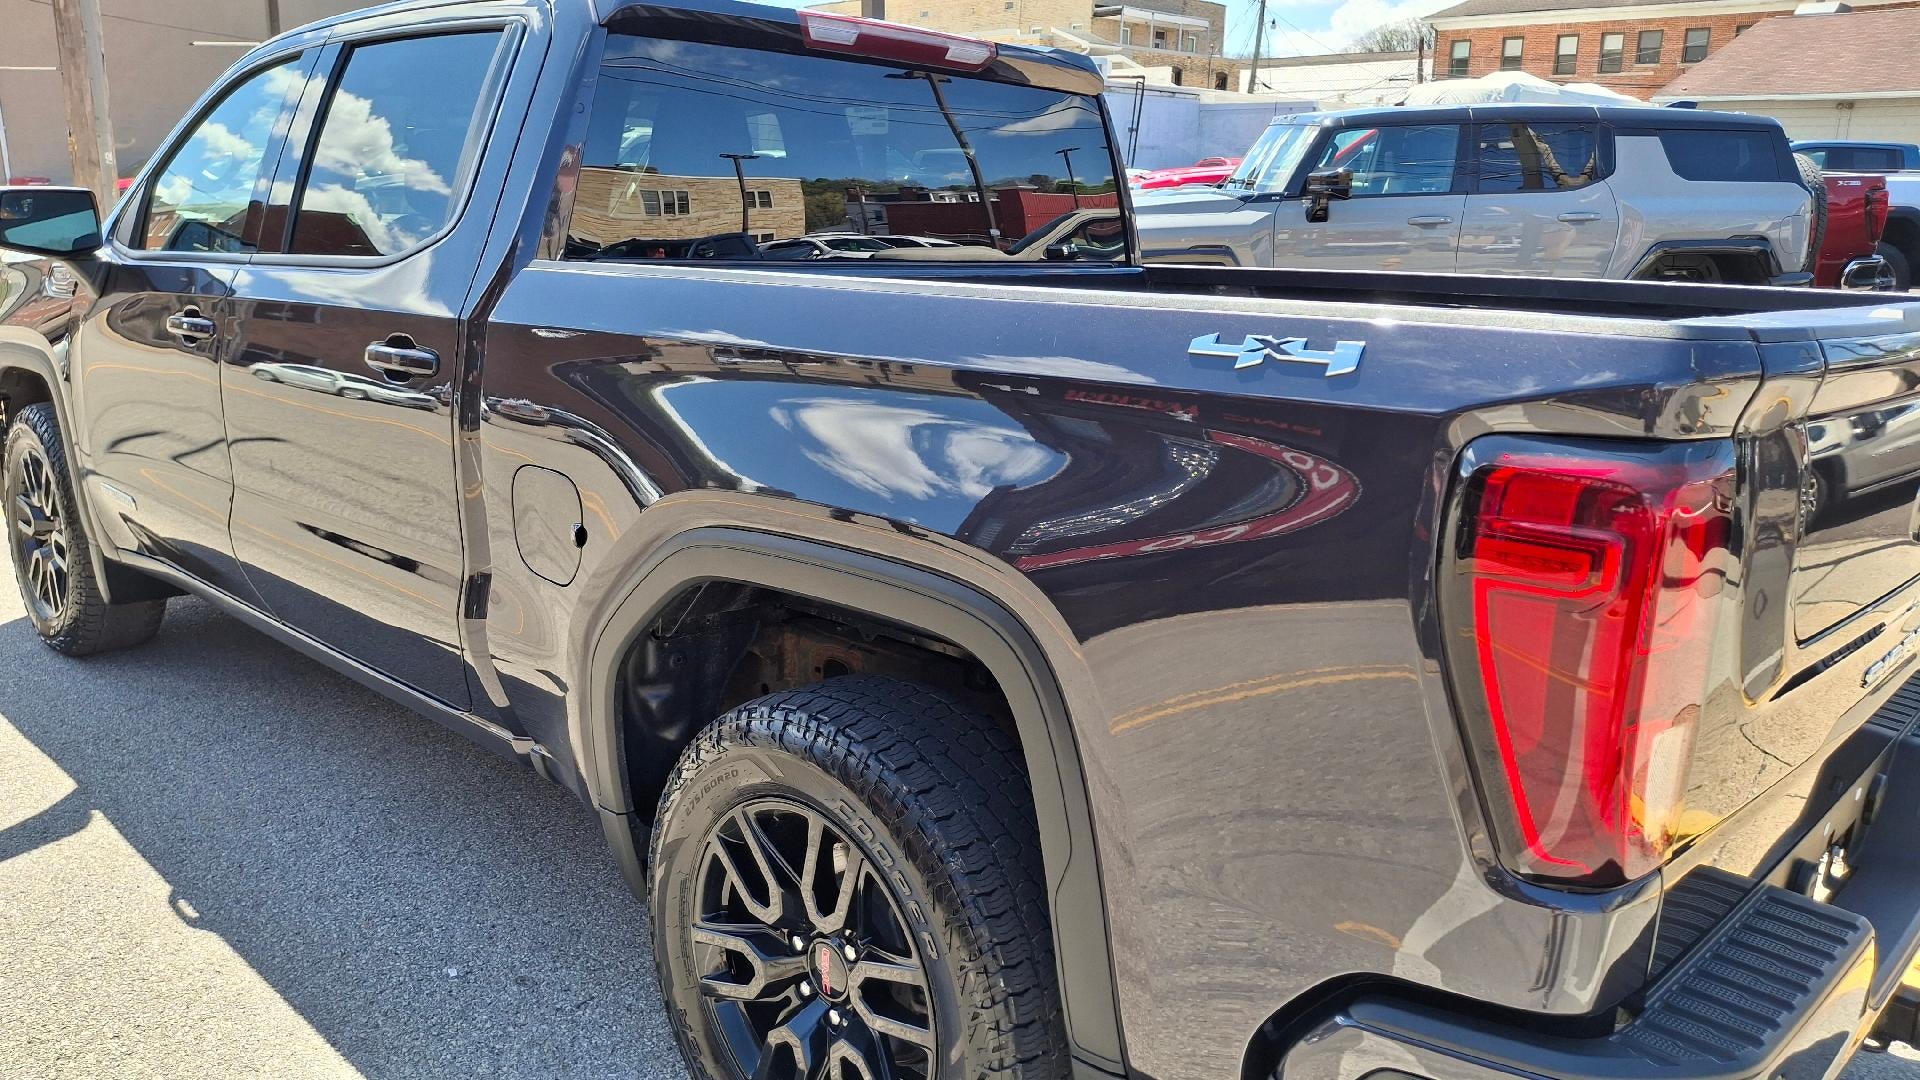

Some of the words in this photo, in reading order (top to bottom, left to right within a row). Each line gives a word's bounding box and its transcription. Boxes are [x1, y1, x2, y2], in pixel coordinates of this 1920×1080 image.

[685, 769, 739, 816] 275/60R20
[834, 798, 940, 961] COOPER
[821, 947, 831, 995] GMC
